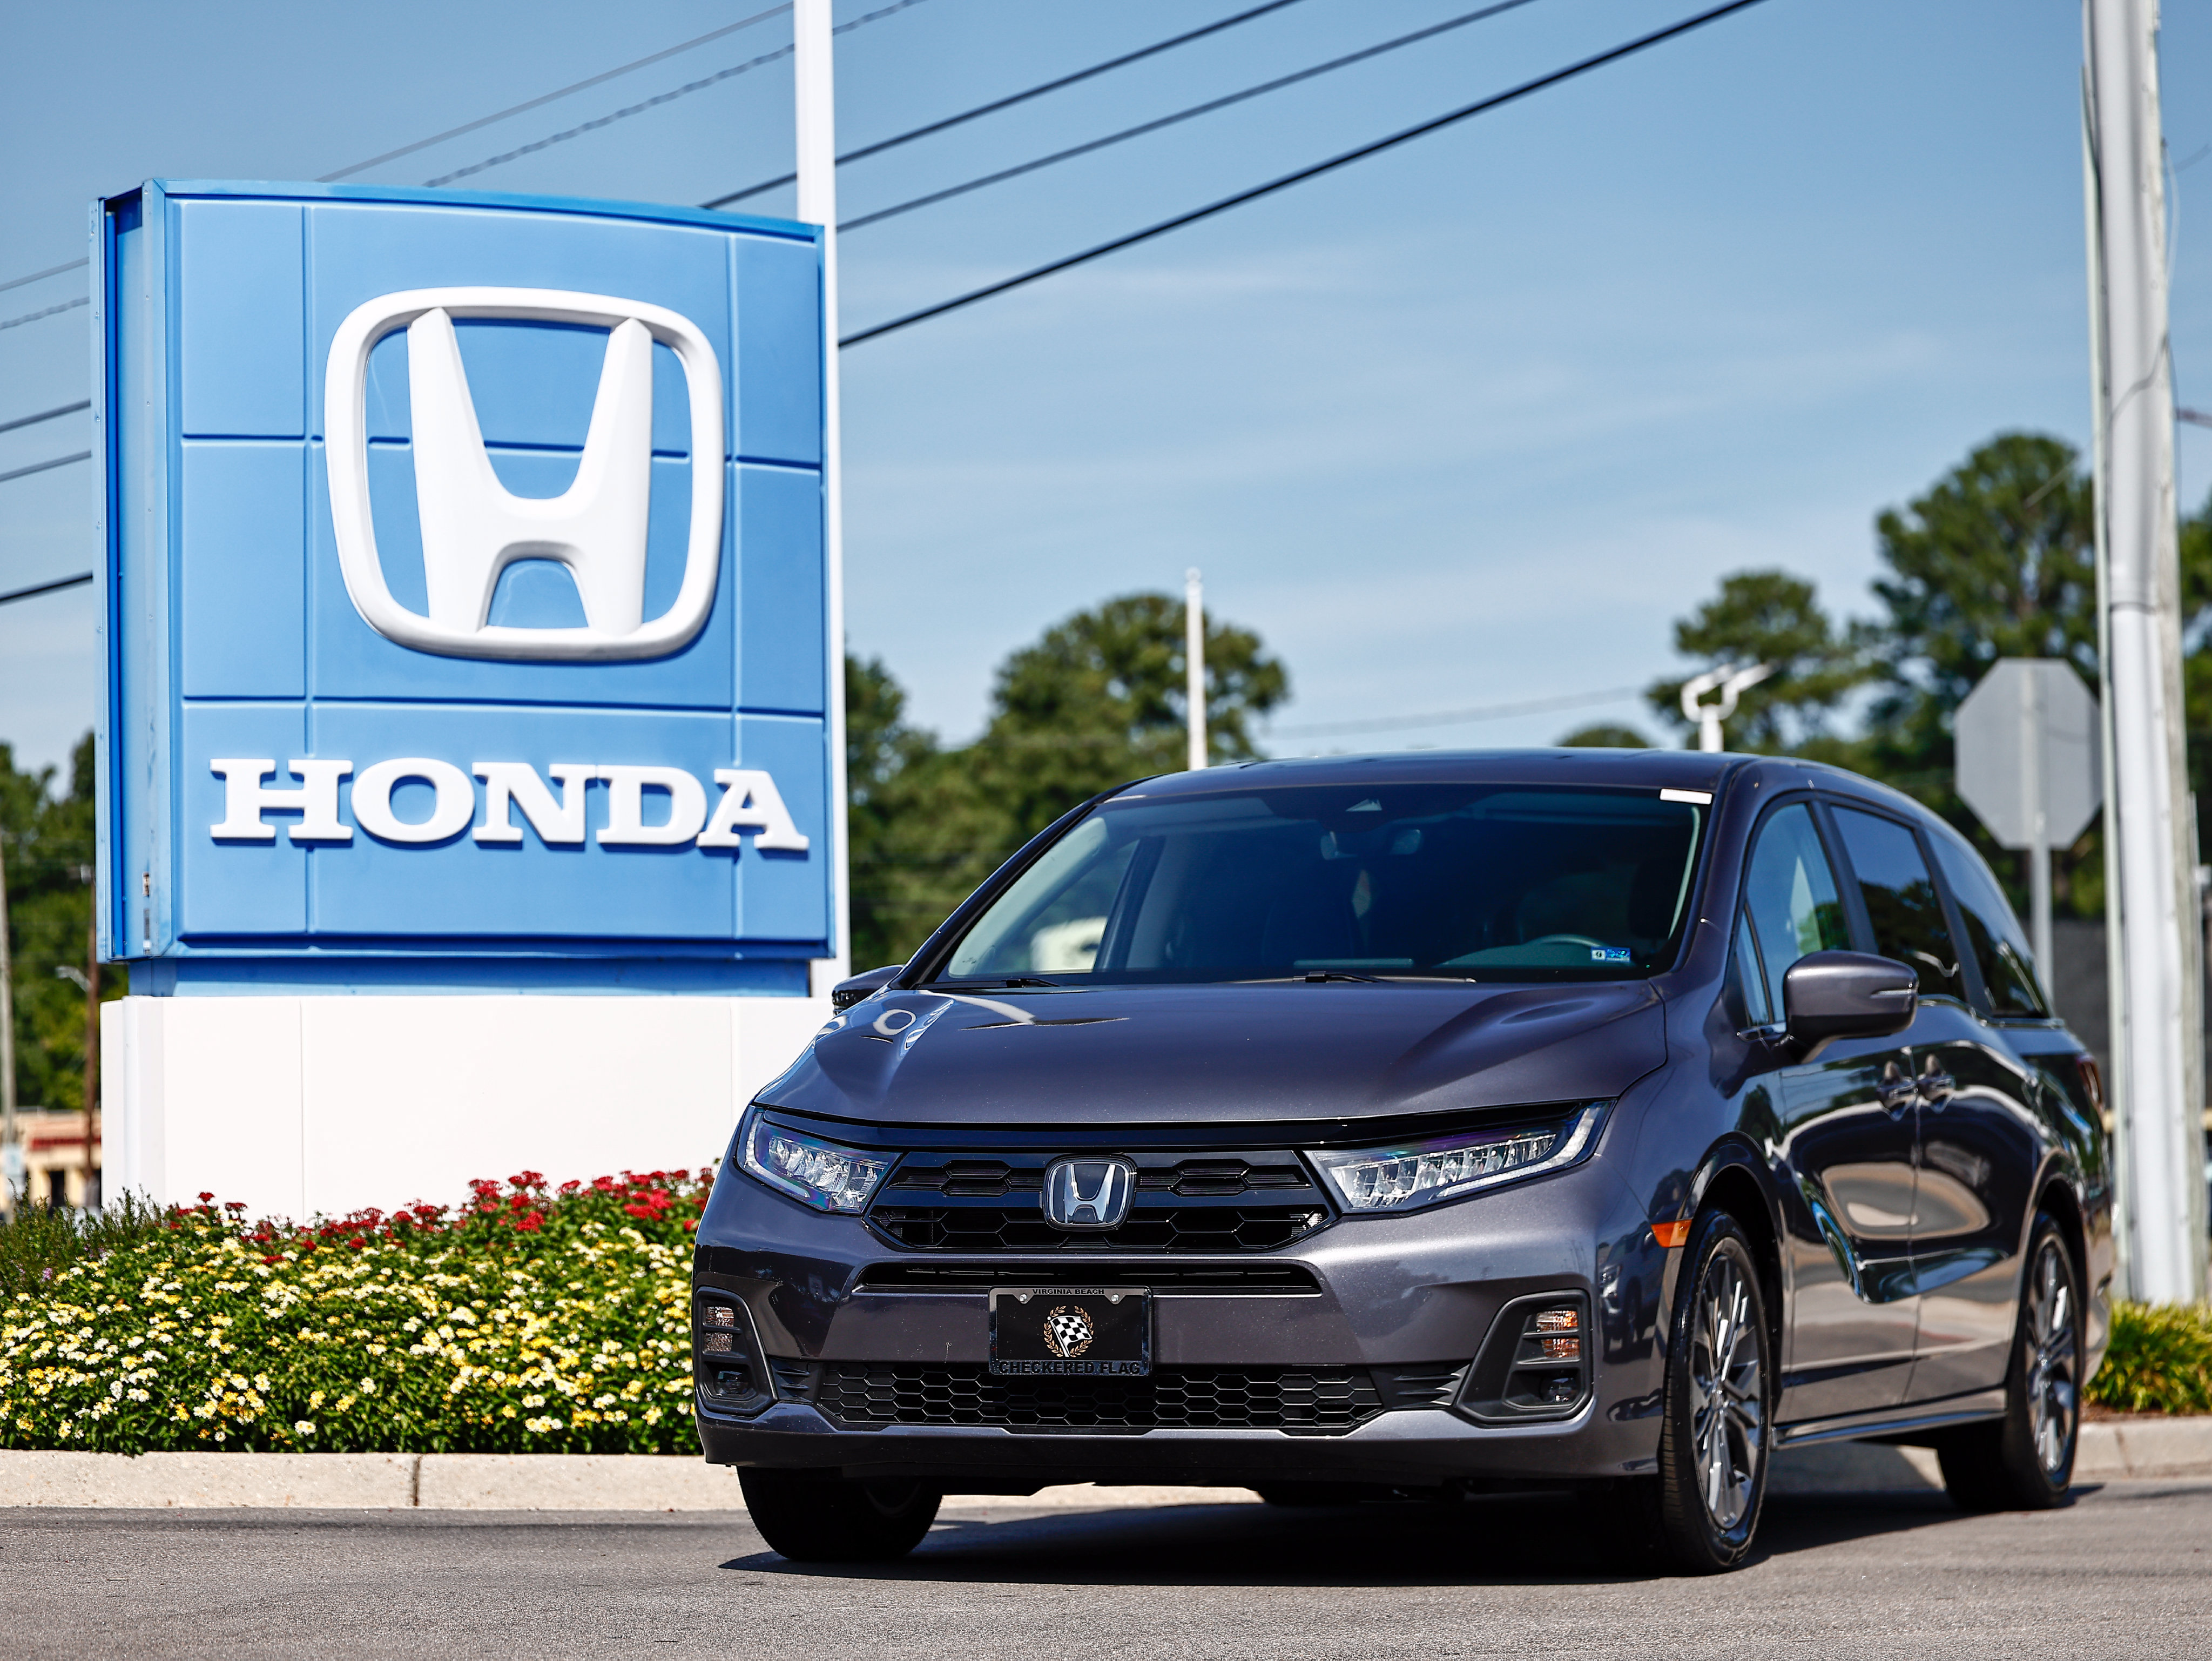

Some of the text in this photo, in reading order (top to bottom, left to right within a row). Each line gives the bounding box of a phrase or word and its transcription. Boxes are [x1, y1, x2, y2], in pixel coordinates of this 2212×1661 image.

[209, 757, 809, 852] HONDA
[999, 1361, 1140, 1374] CHECKERED FLAG
